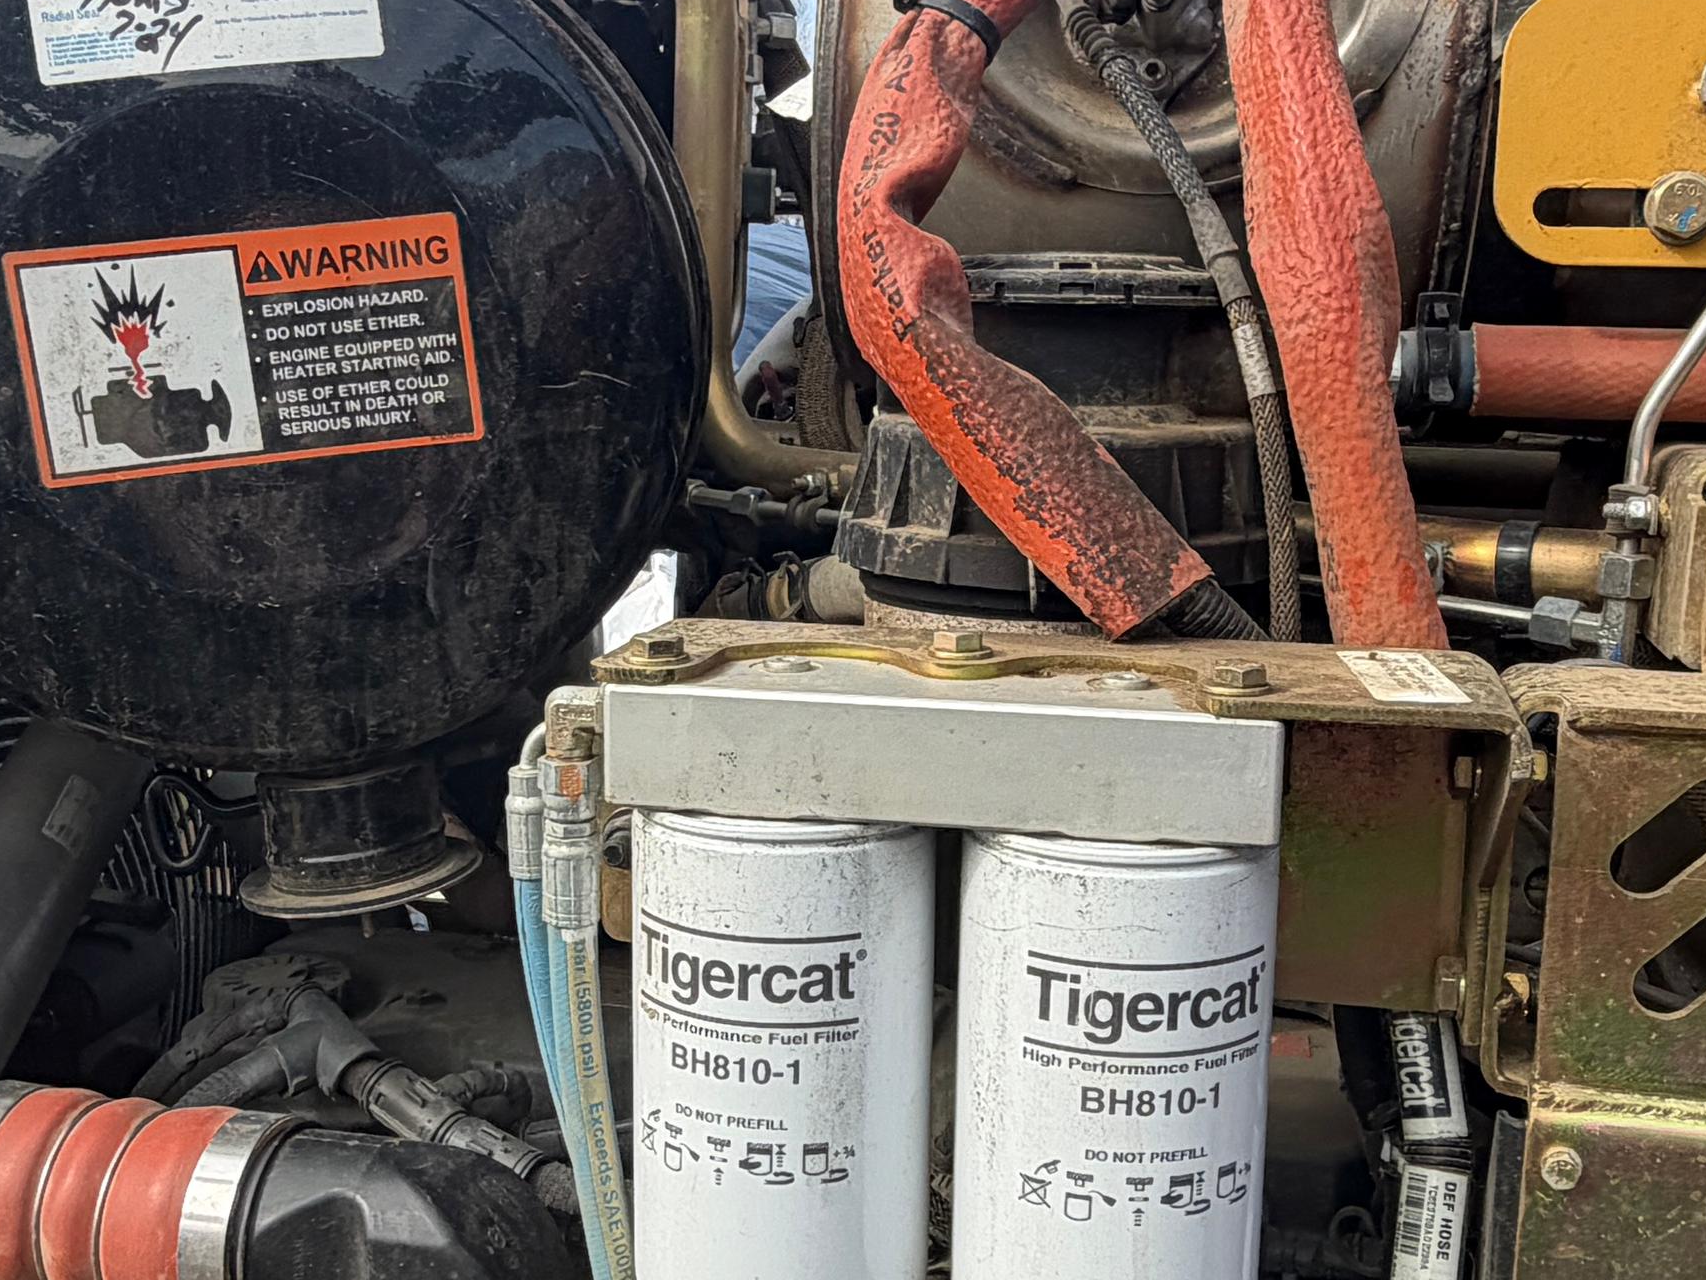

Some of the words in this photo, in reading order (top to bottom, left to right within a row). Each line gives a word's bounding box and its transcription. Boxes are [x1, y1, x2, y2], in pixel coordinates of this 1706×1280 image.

[279, 236, 449, 280] WARNING
[262, 295, 354, 316] EXPLOSION
[358, 289, 429, 308] HAZARD.
[265, 327, 291, 342] DO
[294, 322, 326, 338] NOT
[331, 320, 364, 335] USE
[367, 313, 424, 331] ETHER.
[269, 347, 330, 365] ENGINE
[333, 339, 414, 358] EQUIPPED
[417, 333, 457, 349] WITH
[272, 363, 337, 380] HEATER
[340, 355, 420, 374] STARTING
[423, 351, 455, 365] AID.
[276, 388, 309, 404] USE
[312, 386, 335, 400] OF
[339, 380, 392, 397] ETHER
[396, 374, 449, 391] COULD
[278, 402, 341, 420] RESULT
[345, 400, 361, 414] IN
[365, 395, 418, 412] DEATH
[422, 391, 445, 405] OR
[281, 419, 353, 437] SERIOUS
[355, 410, 417, 428] INJURY.
[662, 1011, 763, 1044] Performance
[767, 1030, 809, 1045] Fuel
[814, 1025, 860, 1044] Filter
[579, 1044, 600, 1080] psi)
[670, 1042, 802, 1086] BH810-1
[1022, 1045, 1062, 1069] High
[1067, 1054, 1189, 1078] Performance
[1193, 1051, 1228, 1071] Fuel
[1390, 1016, 1447, 1108] igercat
[1079, 1082, 1222, 1115] BH810-1
[674, 1103, 692, 1116] DO
[695, 1106, 722, 1123] NOT
[726, 1113, 789, 1131] PREFILL
[588, 1100, 614, 1191] Exceeds
[1084, 1148, 1109, 1161] DO
[1113, 1149, 1147, 1163] NOT
[1148, 1145, 1208, 1162] PREFILL
[1442, 1181, 1458, 1212] DEF
[1436, 1218, 1454, 1261] HOSE
